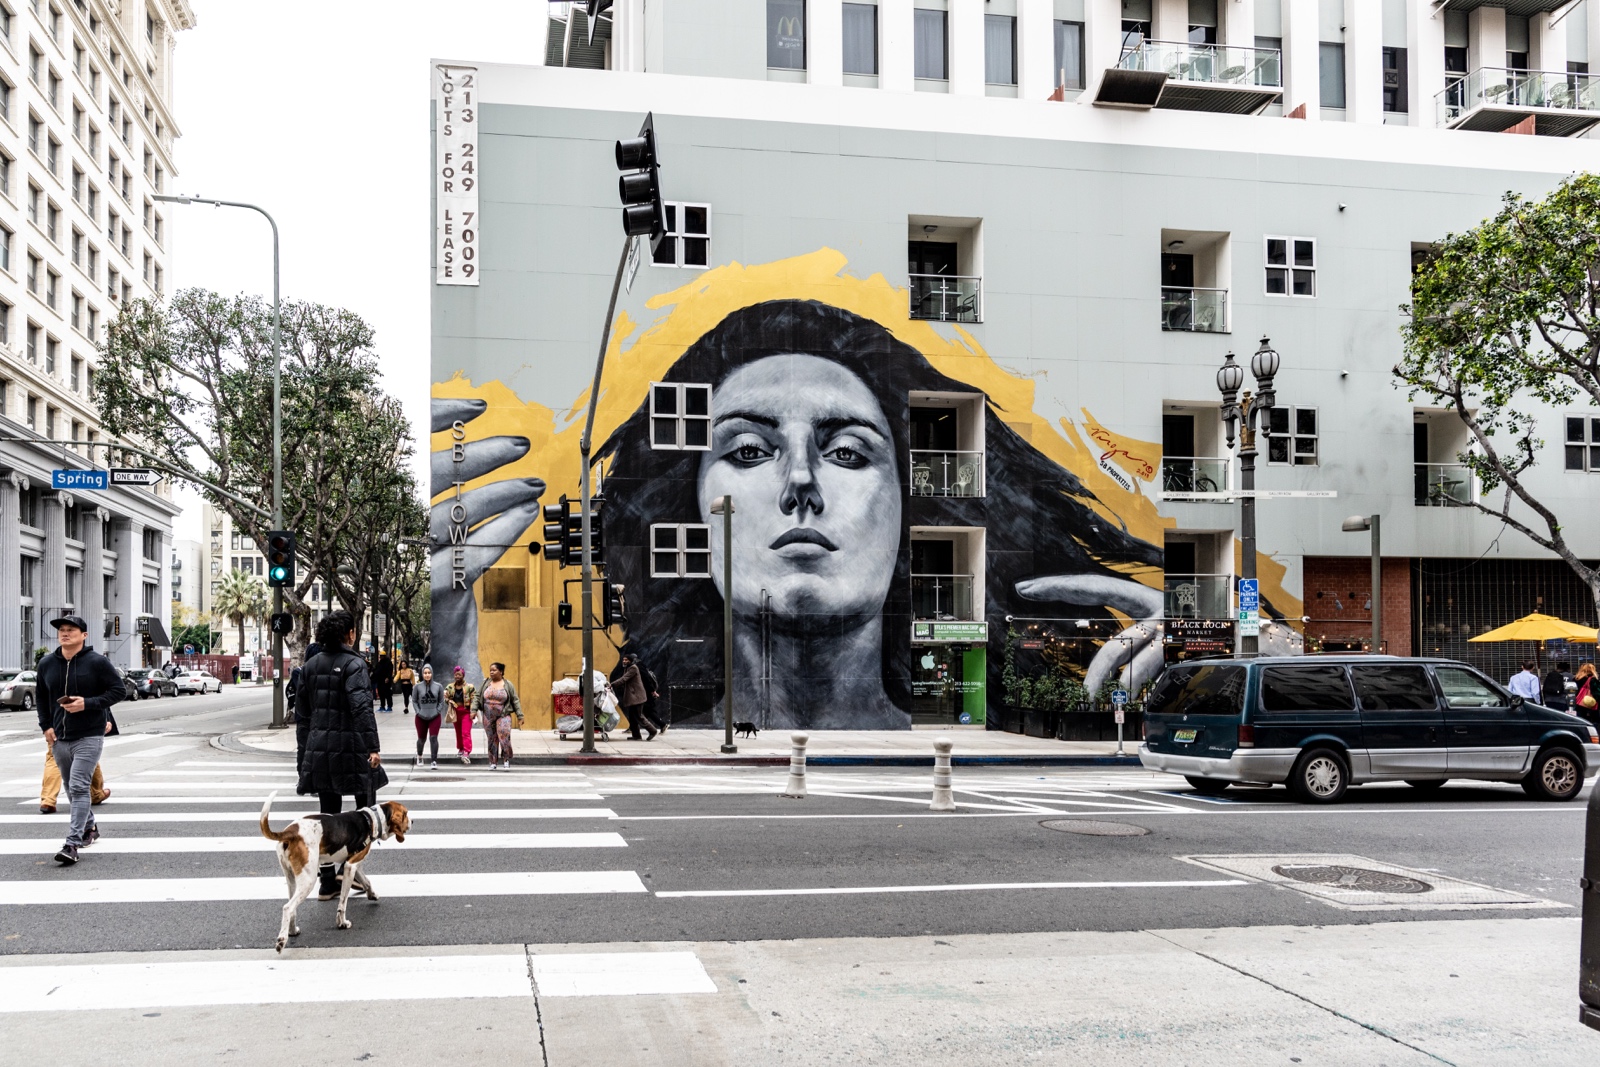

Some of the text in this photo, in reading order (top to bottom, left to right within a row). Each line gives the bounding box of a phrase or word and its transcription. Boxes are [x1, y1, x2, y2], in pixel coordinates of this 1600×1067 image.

[442, 69, 454, 278] LOFTS FOR LEASE
[461, 75, 475, 278] 213 249 7009
[57, 473, 103, 487] Spring
[116, 473, 149, 481] ONE WAY
[448, 420, 469, 590] SB TOWER
[1171, 621, 1227, 629] BLACK ROCK
